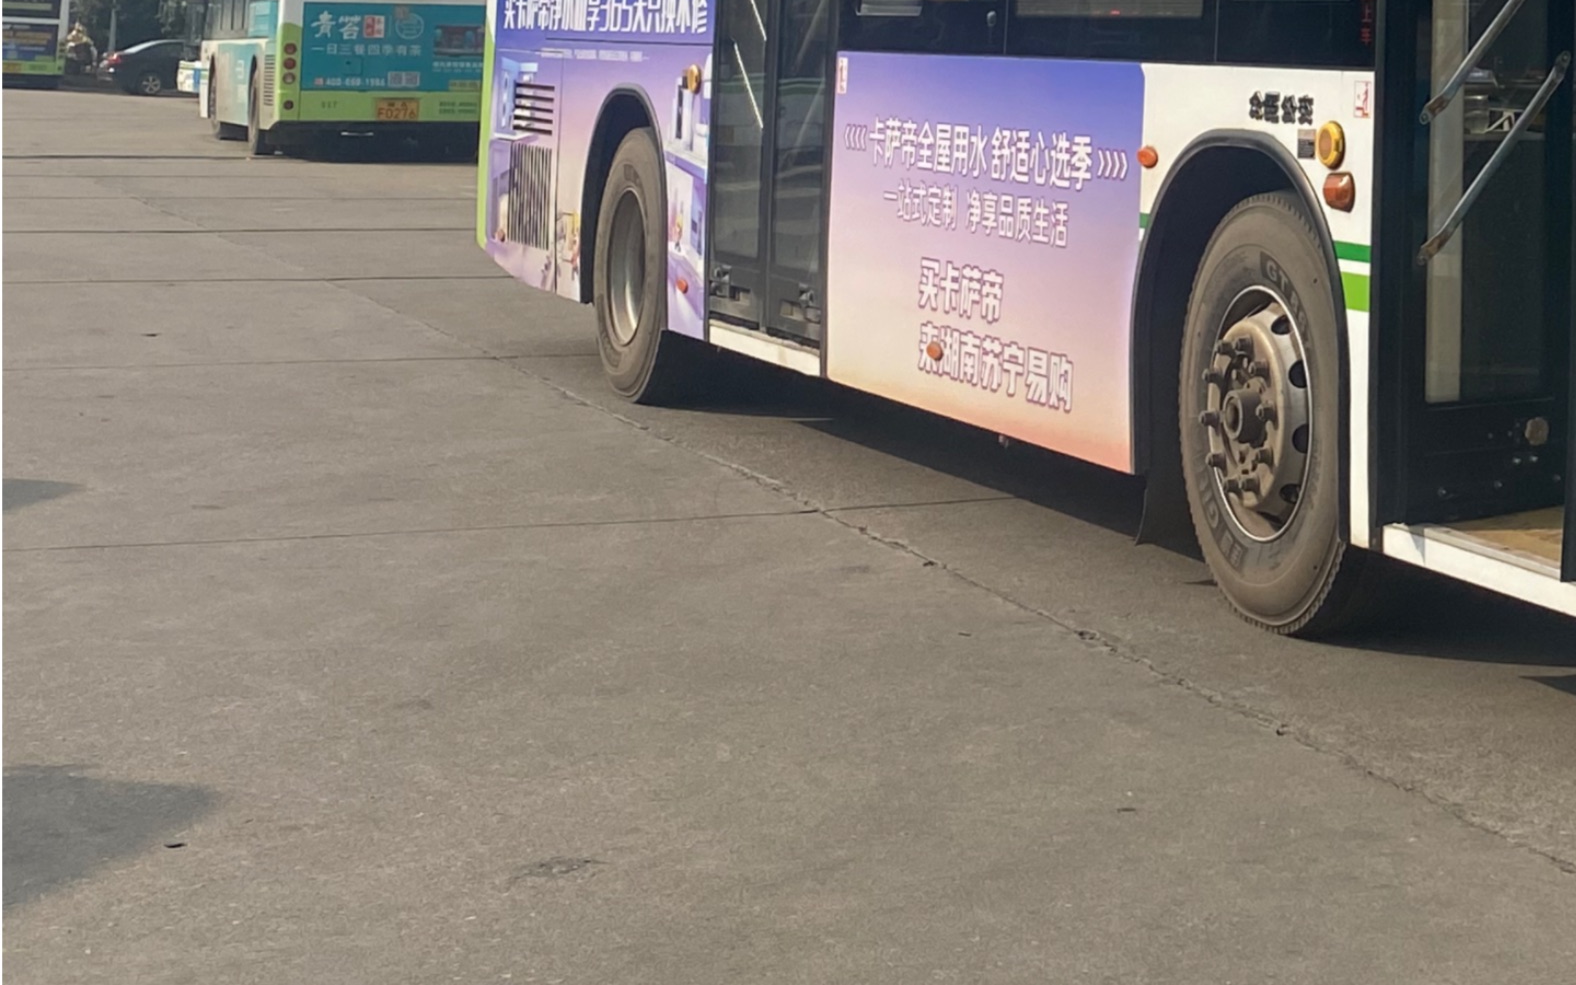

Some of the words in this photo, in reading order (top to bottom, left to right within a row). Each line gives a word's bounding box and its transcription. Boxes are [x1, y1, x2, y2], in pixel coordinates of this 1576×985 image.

[377, 107, 417, 119] F0276
[868, 116, 990, 180] 卡萨帝全屋用水
[991, 125, 1093, 192] 舒适心选季
[883, 180, 959, 232] 一站式定制
[964, 188, 1069, 249] 净享品质生活
[918, 256, 1004, 324] 买卡萨帝
[918, 320, 1074, 413] 来湖南苏宁易购
